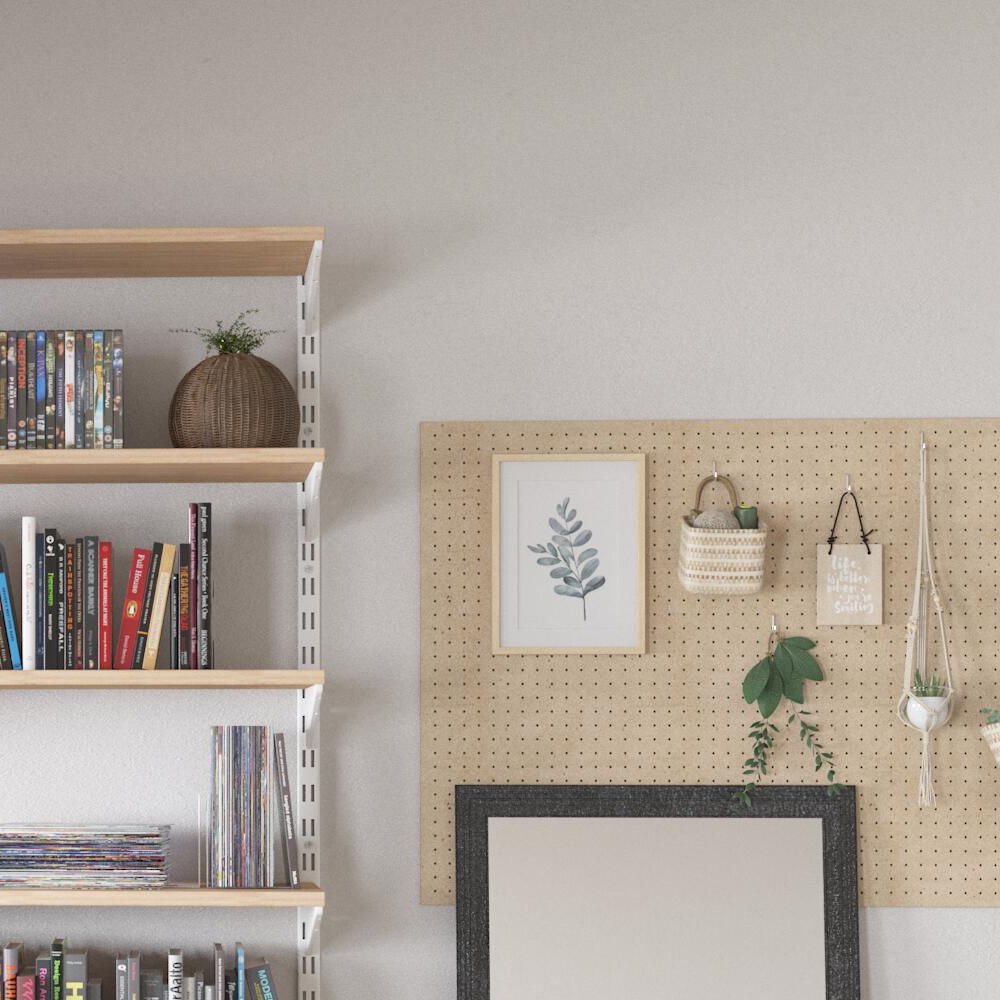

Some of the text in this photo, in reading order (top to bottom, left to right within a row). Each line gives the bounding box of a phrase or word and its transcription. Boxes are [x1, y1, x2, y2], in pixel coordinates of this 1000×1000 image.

[18, 339, 26, 389] INCEPTION
[132, 554, 145, 594] Full House
[39, 968, 47, 986] Ron
[53, 960, 61, 985] Design
